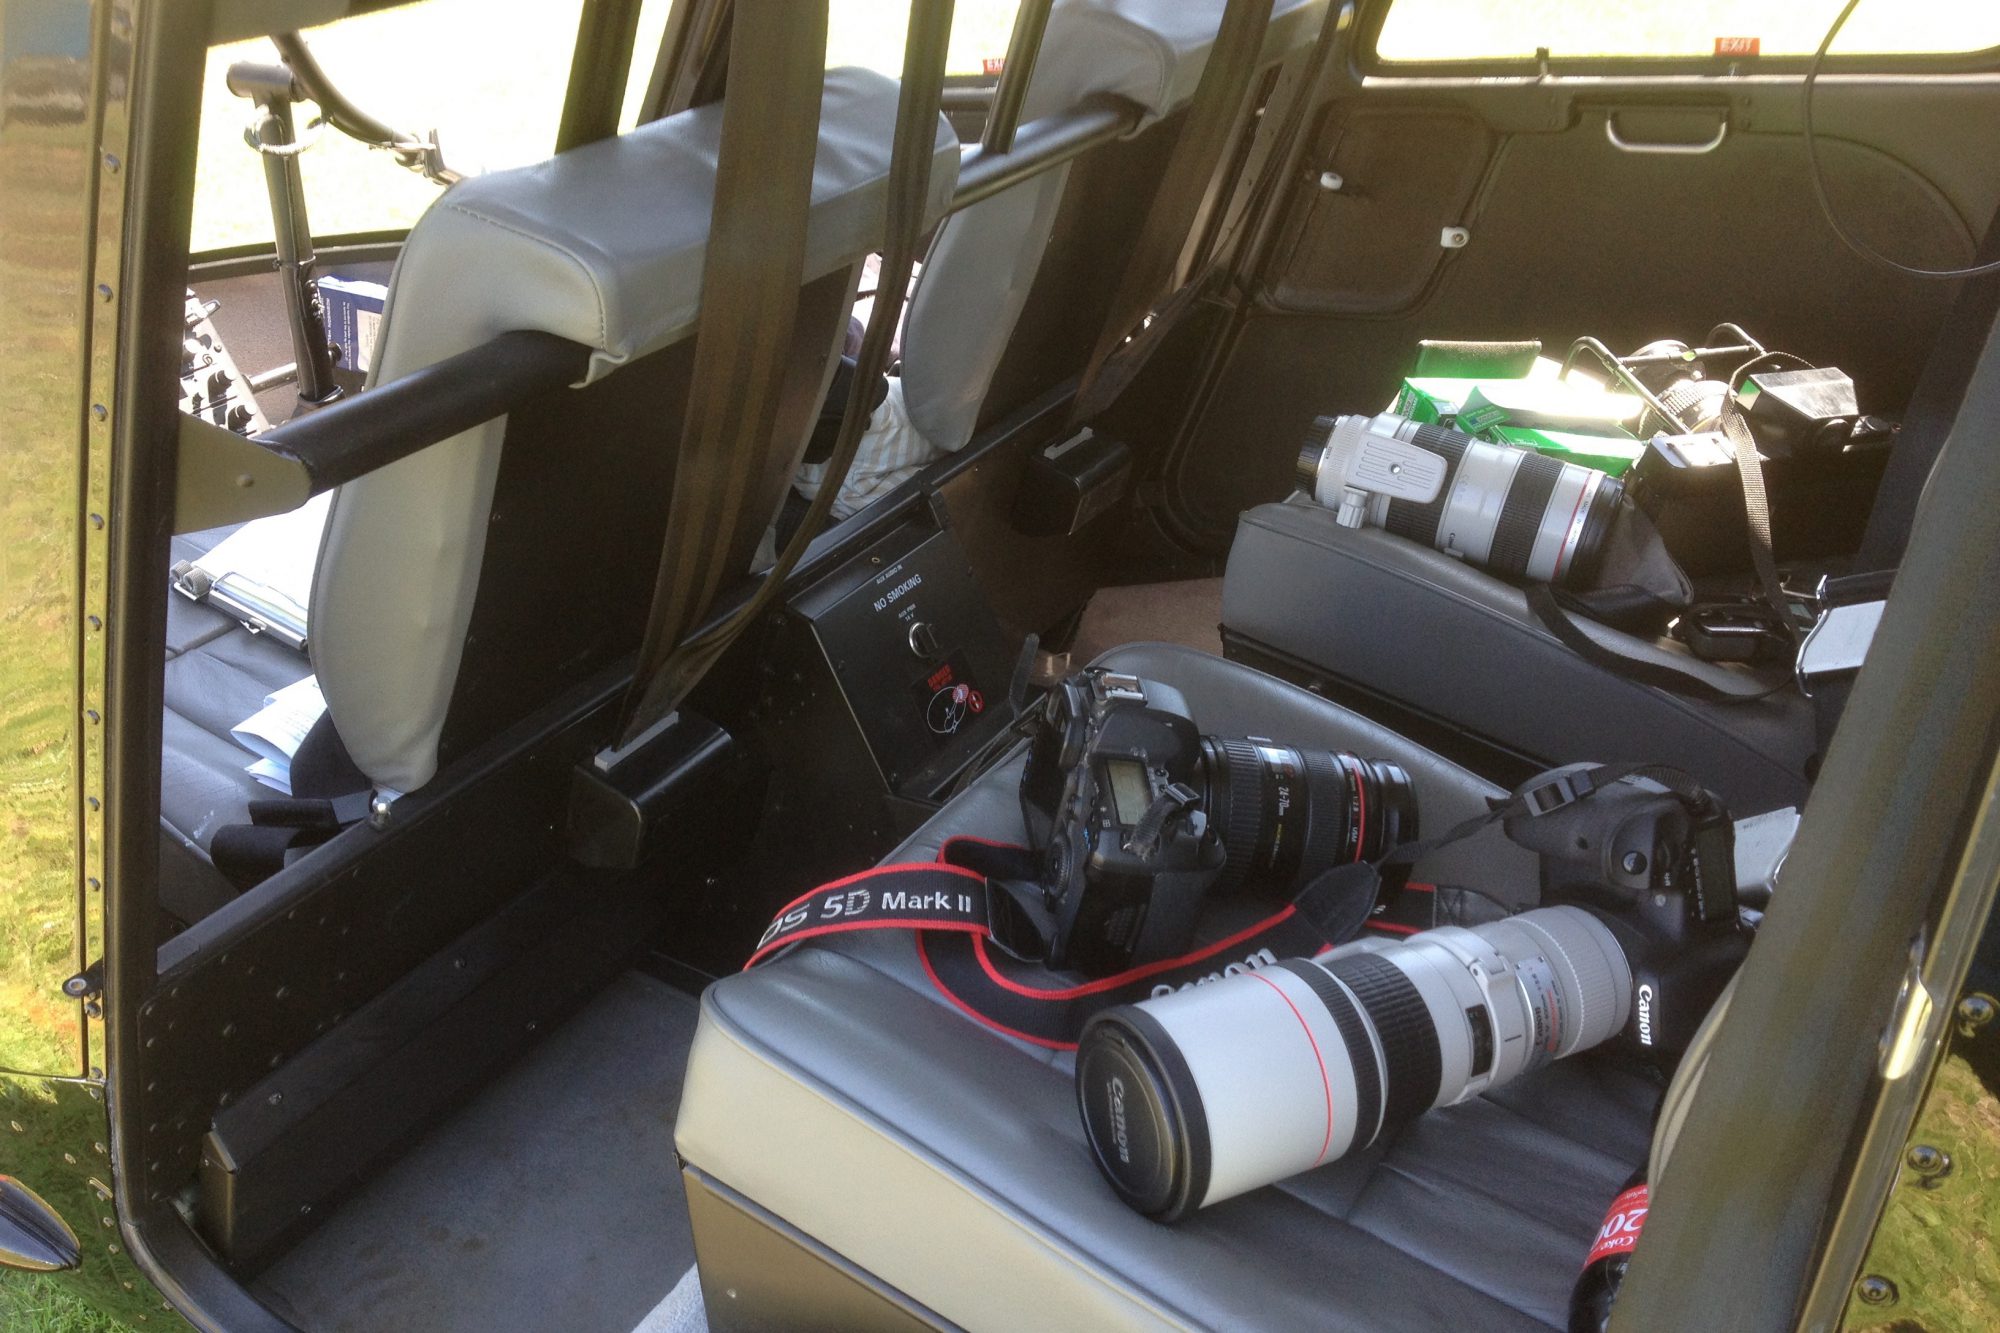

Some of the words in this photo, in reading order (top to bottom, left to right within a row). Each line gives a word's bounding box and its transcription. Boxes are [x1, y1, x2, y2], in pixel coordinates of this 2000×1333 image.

[1720, 37, 1753, 51] EXIT
[873, 597, 887, 612] NO
[887, 574, 922, 603] SMOKING
[820, 889, 871, 919] 5D
[881, 891, 951, 910] Mark
[958, 894, 971, 912] II
[1638, 984, 1652, 1045] Canon
[1111, 1077, 1130, 1164] Canon
[1601, 1235, 1634, 1250] Coke
